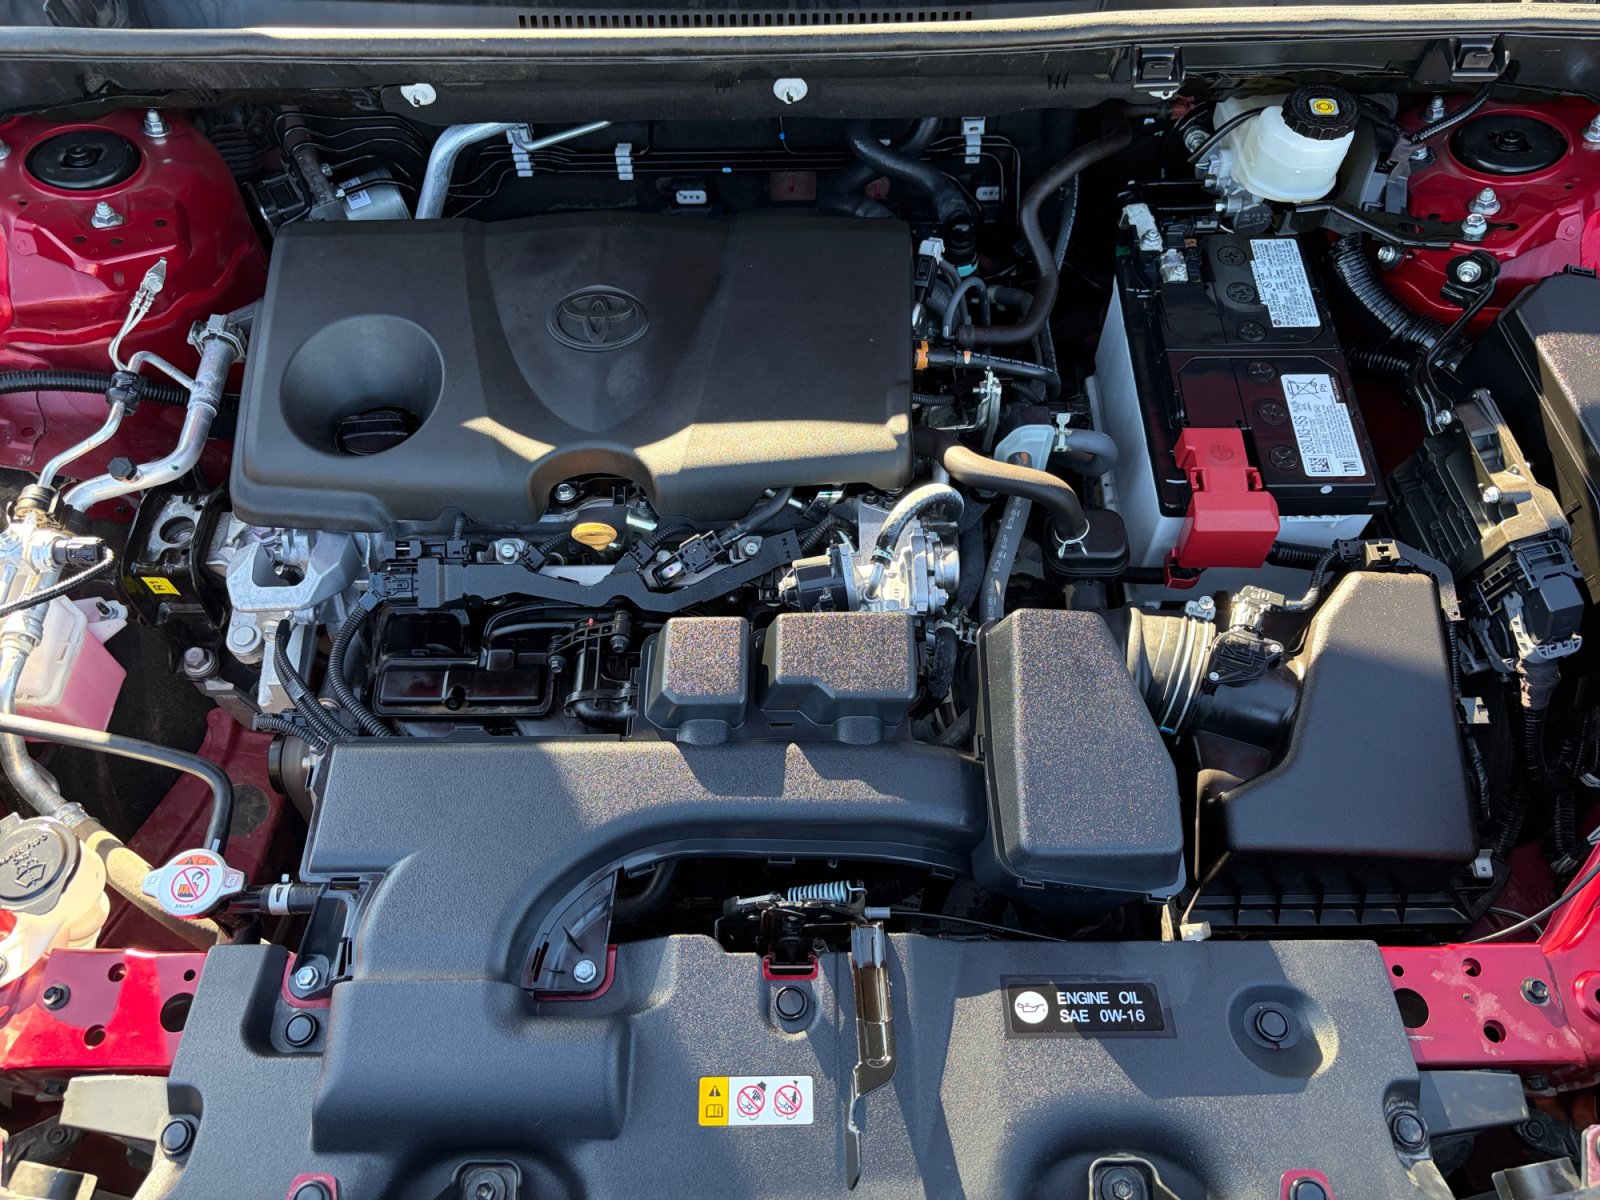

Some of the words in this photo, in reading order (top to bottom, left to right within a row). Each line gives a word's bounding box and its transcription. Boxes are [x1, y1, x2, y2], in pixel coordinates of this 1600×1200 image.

[1320, 383, 1329, 393] Pb
[1342, 461, 1359, 473] TM
[1056, 991, 1110, 1005] ENGINE
[1118, 991, 1143, 1005] OIL
[1059, 1009, 1090, 1023] SAE
[1100, 1009, 1146, 1023] 0W-16
